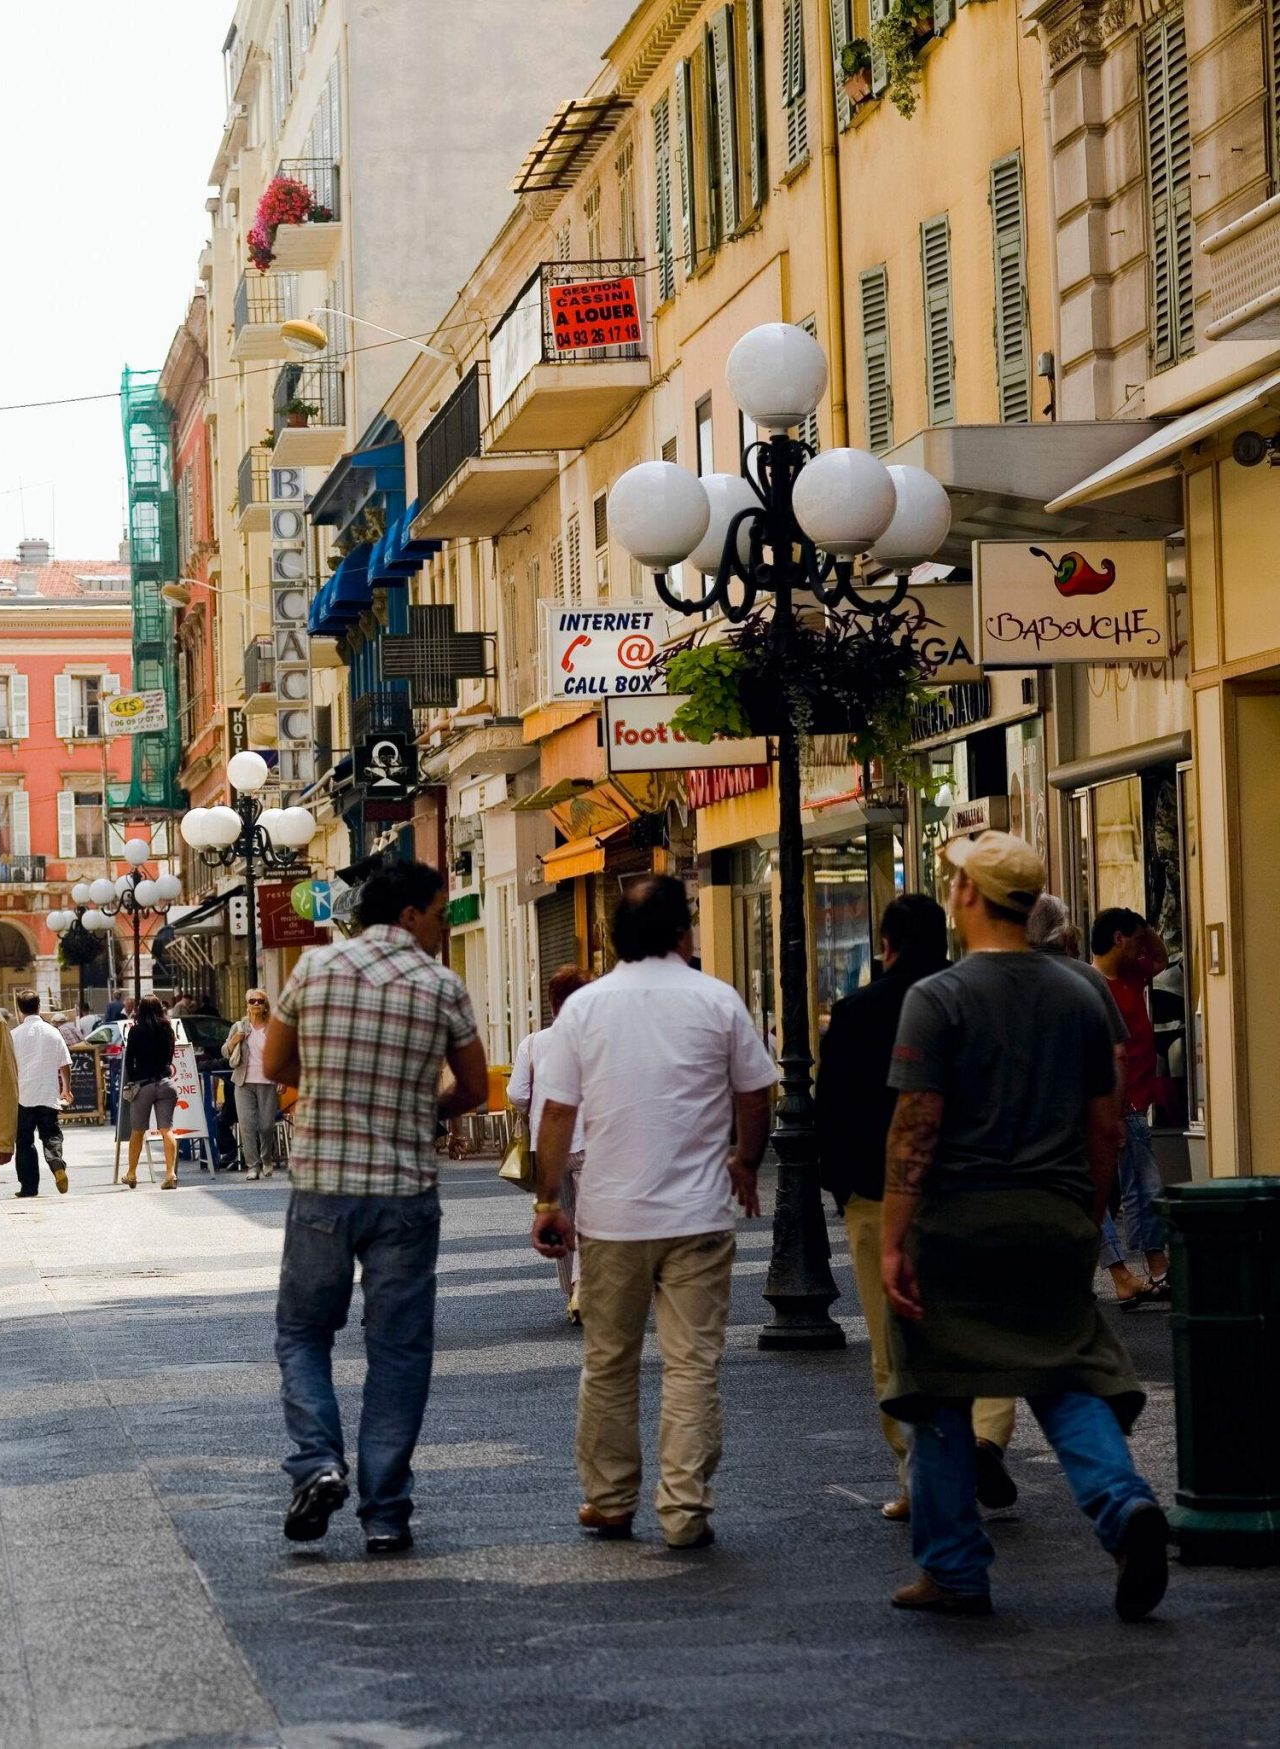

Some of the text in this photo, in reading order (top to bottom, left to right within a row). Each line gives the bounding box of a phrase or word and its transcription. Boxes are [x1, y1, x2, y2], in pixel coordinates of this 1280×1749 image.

[556, 290, 630, 308] CASSINI
[562, 281, 622, 297] GESTION
[555, 304, 635, 326] A LOUER
[557, 323, 639, 348] 04 93 26 17 18
[559, 612, 654, 631] INTERNET
[985, 608, 1161, 651] BABOUCHE
[564, 675, 653, 695] CALL BOX
[233, 711, 244, 754] HOTE
